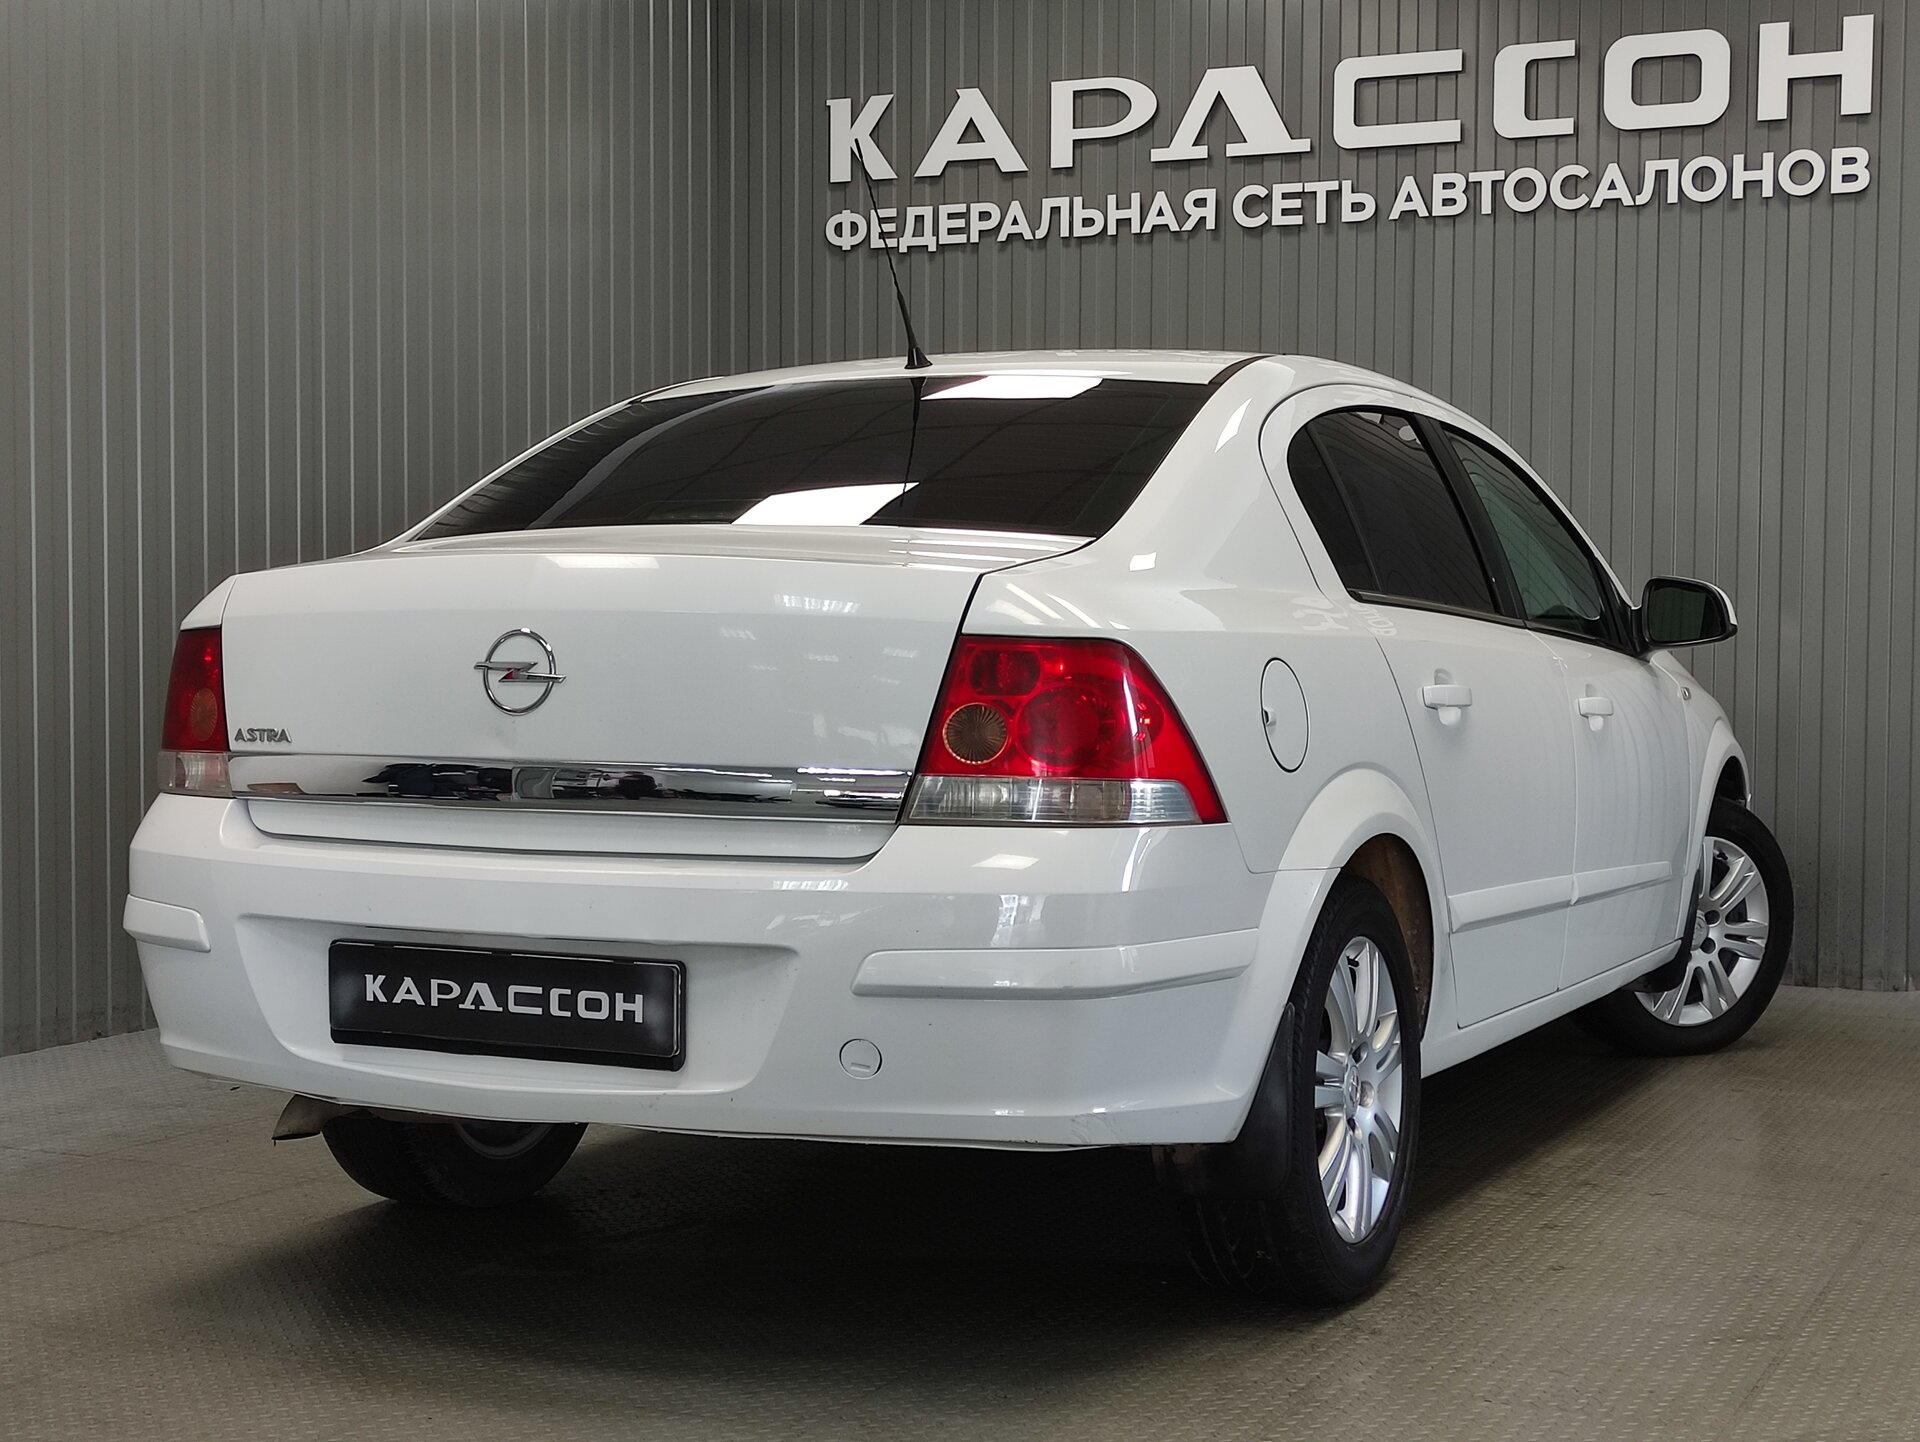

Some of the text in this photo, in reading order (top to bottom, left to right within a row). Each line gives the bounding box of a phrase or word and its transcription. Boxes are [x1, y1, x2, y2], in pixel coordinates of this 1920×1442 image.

[825, 146, 1871, 253] ФЕДЕРАЛЬНАЯ СЕТЬ АВТОСАЛОНОВ
[234, 727, 292, 743] ASTRA
